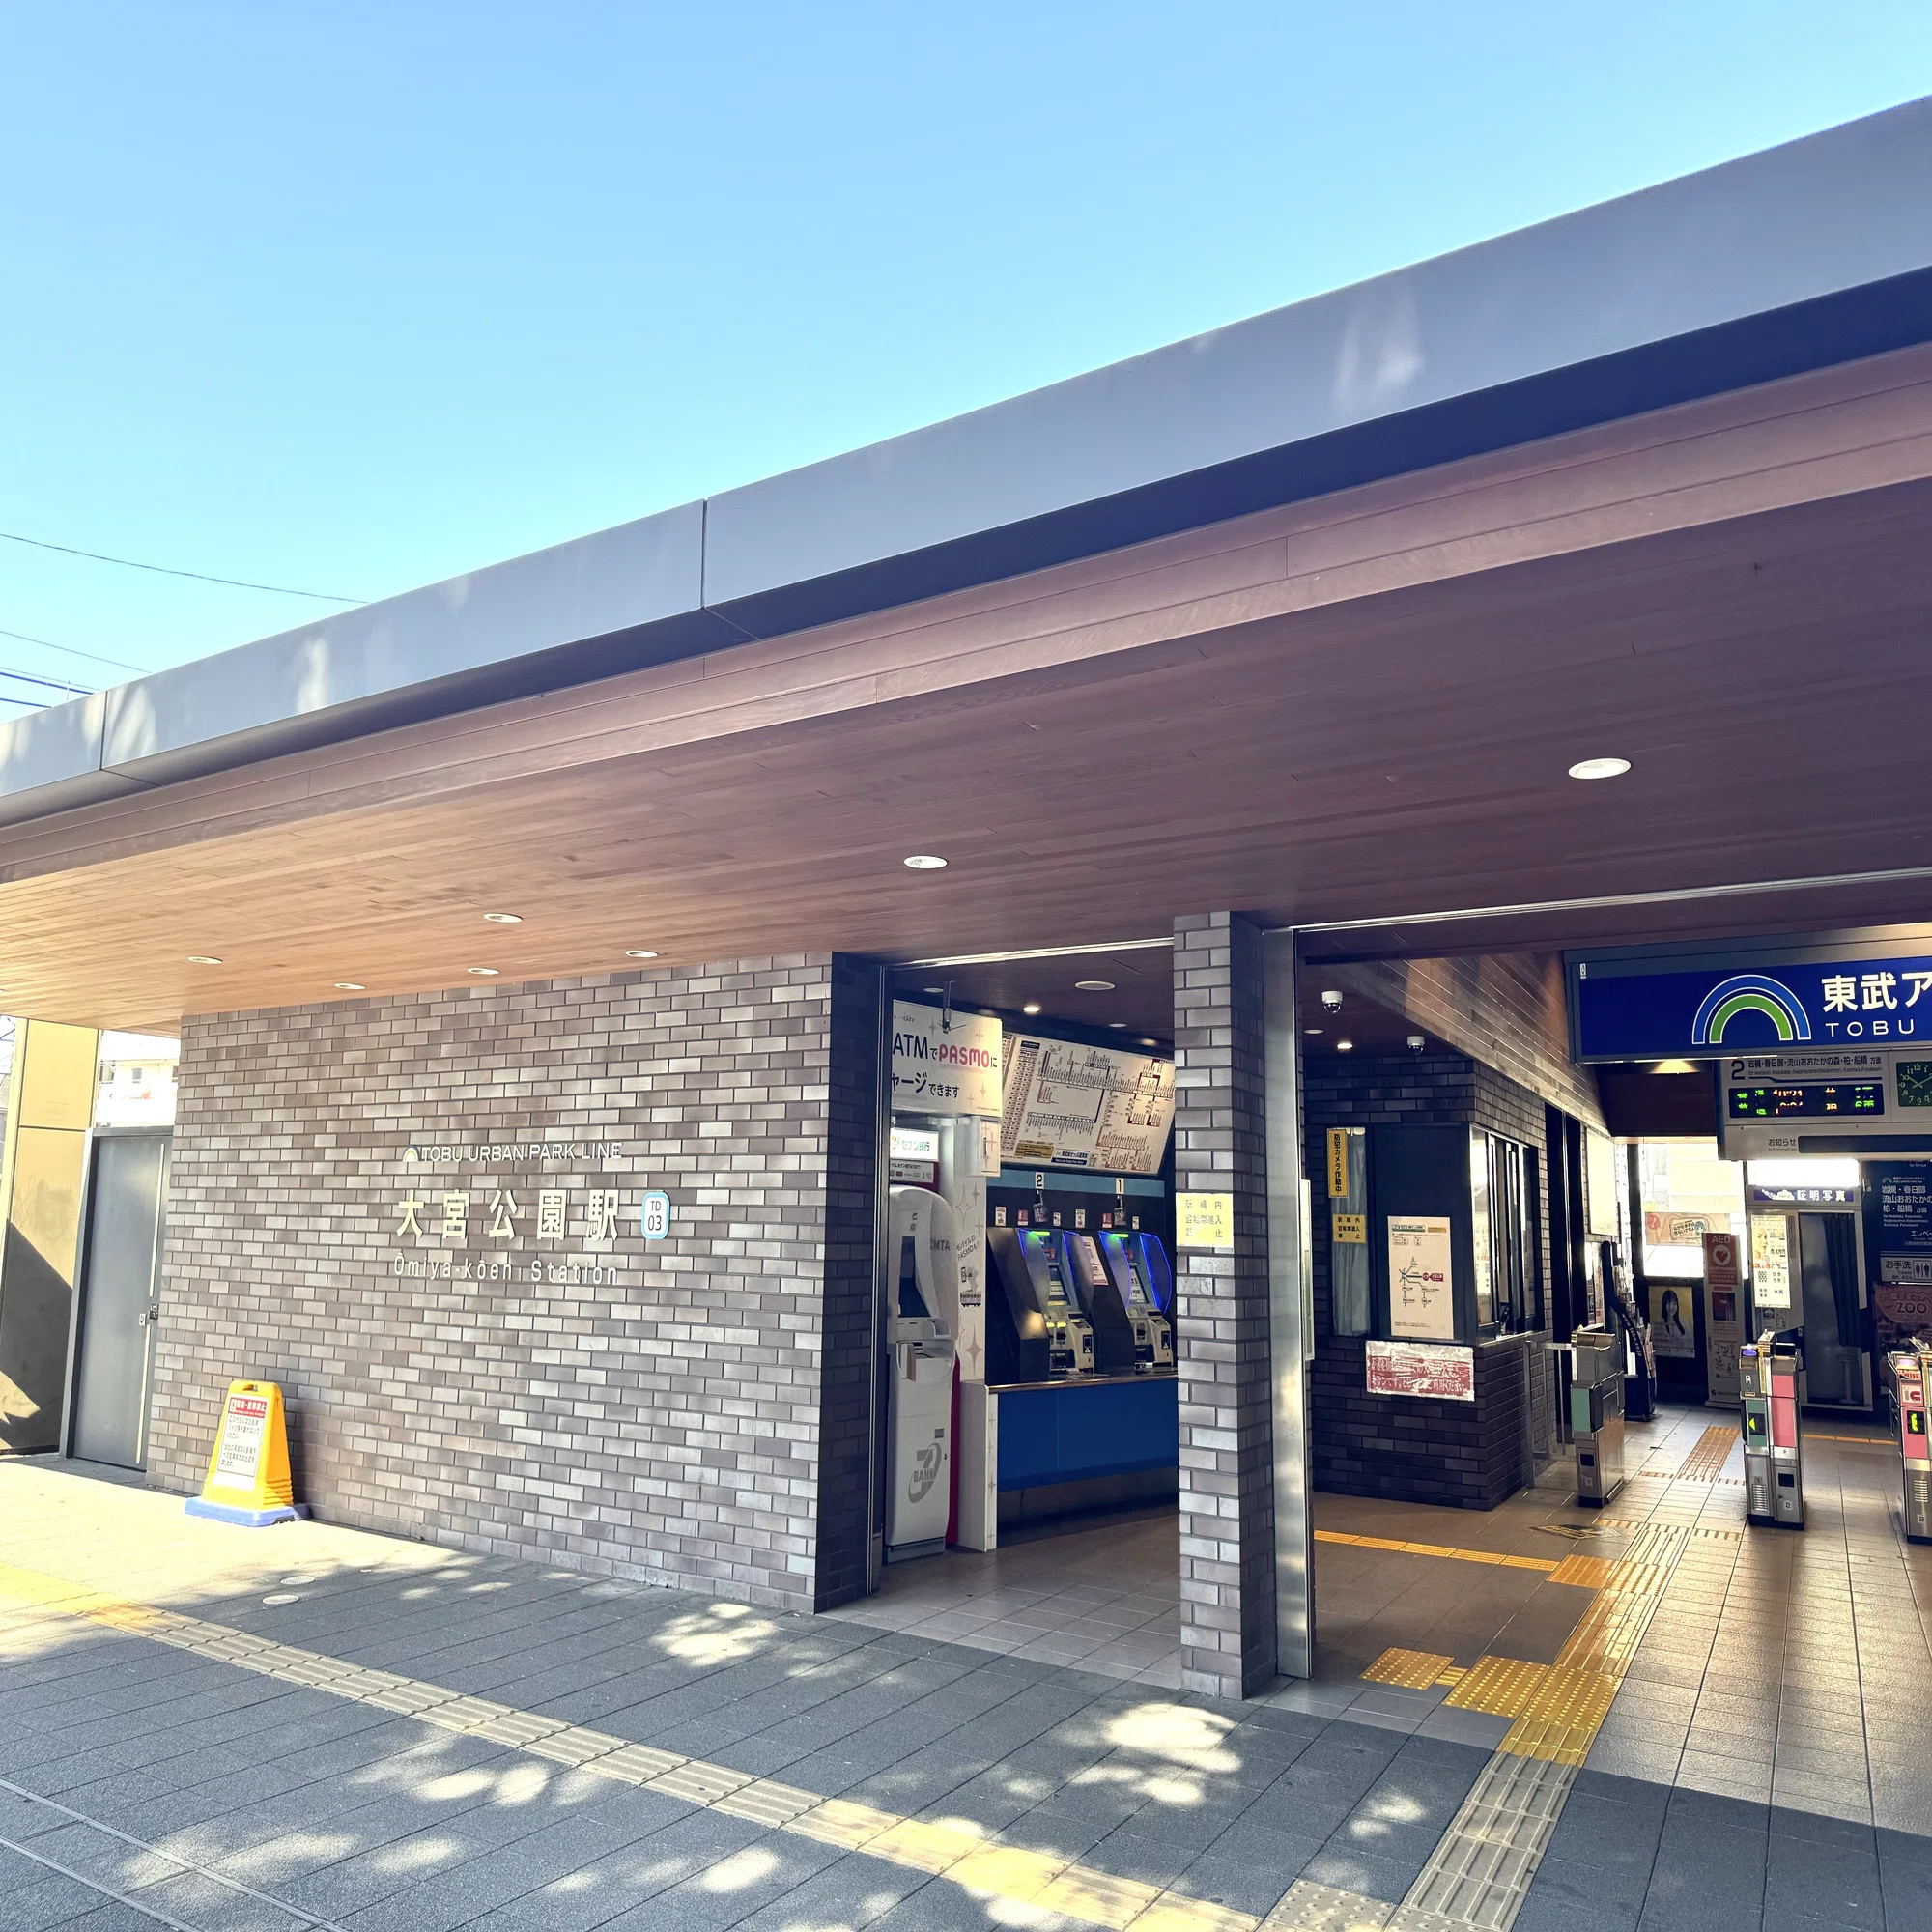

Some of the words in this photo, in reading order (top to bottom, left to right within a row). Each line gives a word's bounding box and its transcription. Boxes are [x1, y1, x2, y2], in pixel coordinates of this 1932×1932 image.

[1821, 972, 1932, 1012] 東武ア
[1825, 1019, 1914, 1037] TOBU
[1731, 1060, 1745, 1080] 2
[1768, 1138, 1797, 1147] お知らせ
[421, 1145, 463, 1162] TOBU
[469, 1144, 525, 1161] URBAN
[529, 1143, 576, 1160] PARK
[581, 1142, 623, 1159] LINE
[1037, 1174, 1043, 1187] 2
[1118, 1179, 1122, 1192] 1
[650, 1200, 661, 1211] TD
[396, 1189, 619, 1241] 大宮公園駅
[648, 1215, 662, 1232] 03
[1712, 1236, 1731, 1244] AED
[394, 1252, 513, 1281] Ōmiya-kōen
[531, 1259, 618, 1285] Station
[1896, 1302, 1927, 1314] ZOO
[914, 1467, 935, 1482] BANK
